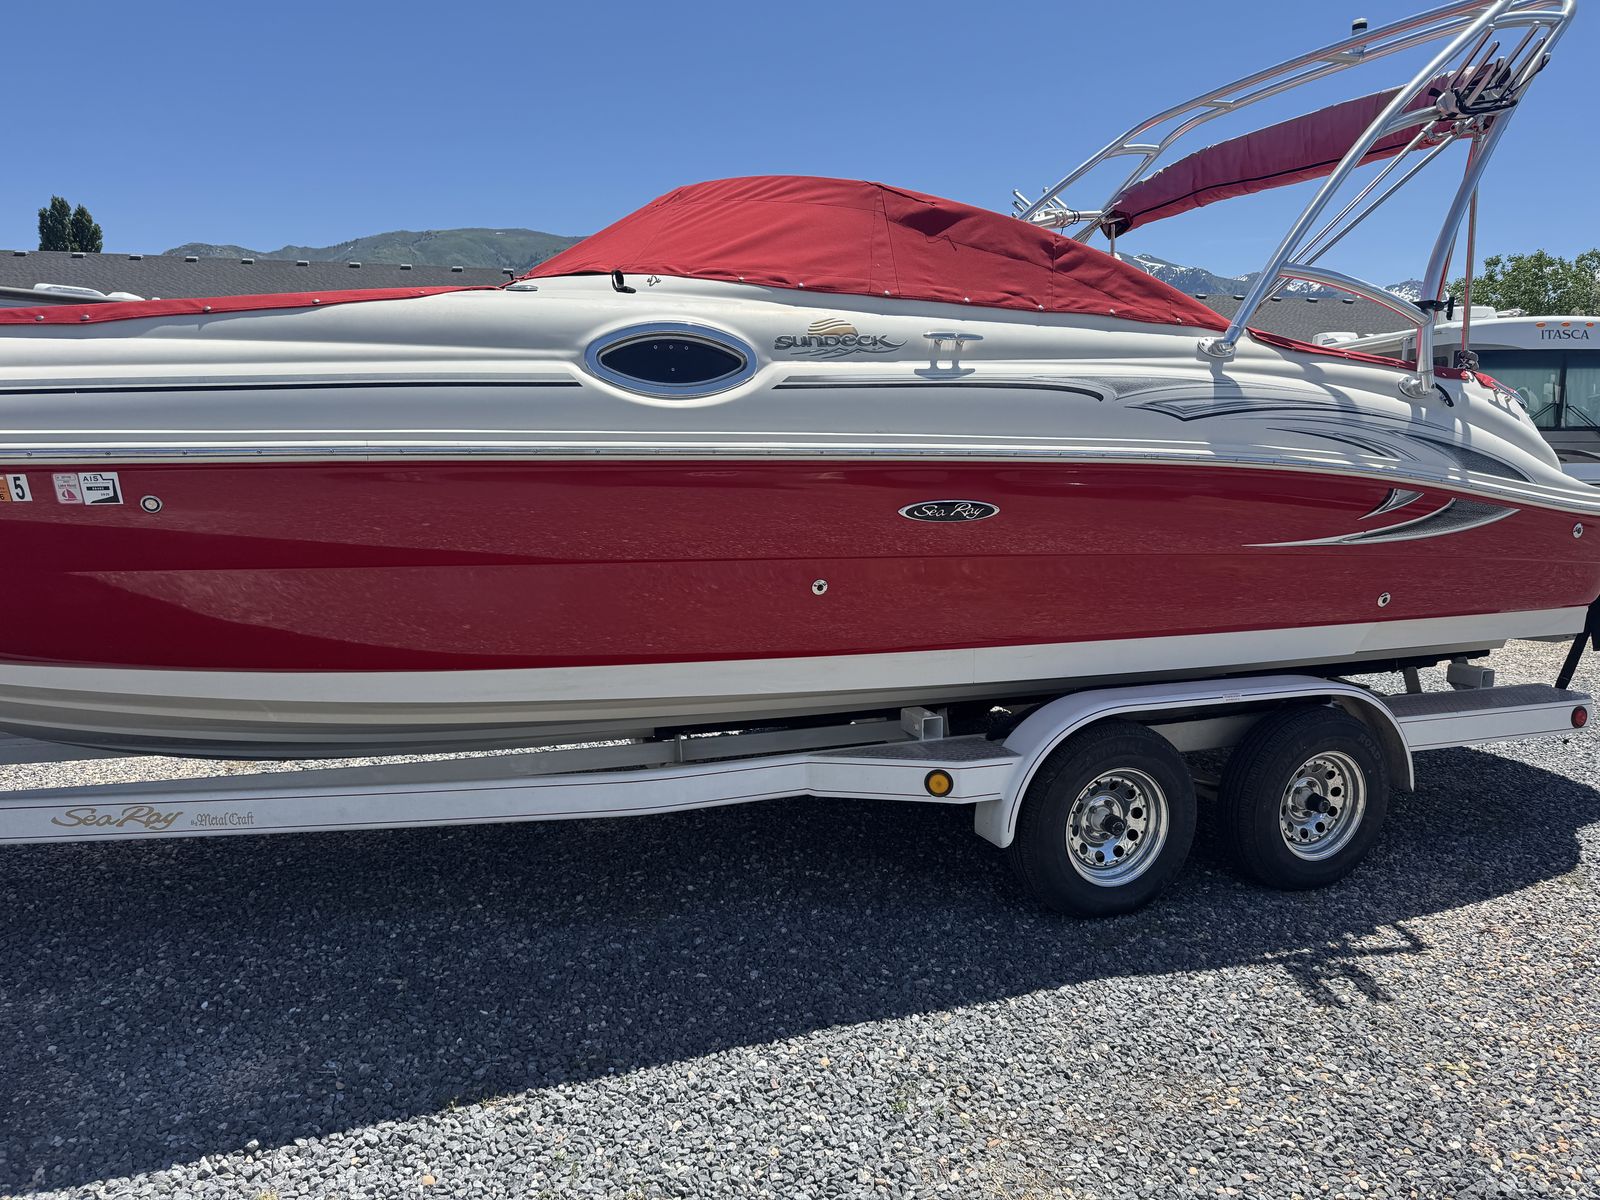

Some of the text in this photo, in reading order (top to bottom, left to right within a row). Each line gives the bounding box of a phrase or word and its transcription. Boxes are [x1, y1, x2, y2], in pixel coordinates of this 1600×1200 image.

[1541, 329, 1589, 340] ITASCA
[13, 476, 26, 500] 5
[914, 502, 985, 519] Sea Ray
[51, 805, 183, 830] Sea Ray
[196, 812, 229, 827] Metal
[229, 811, 255, 826] Craft
